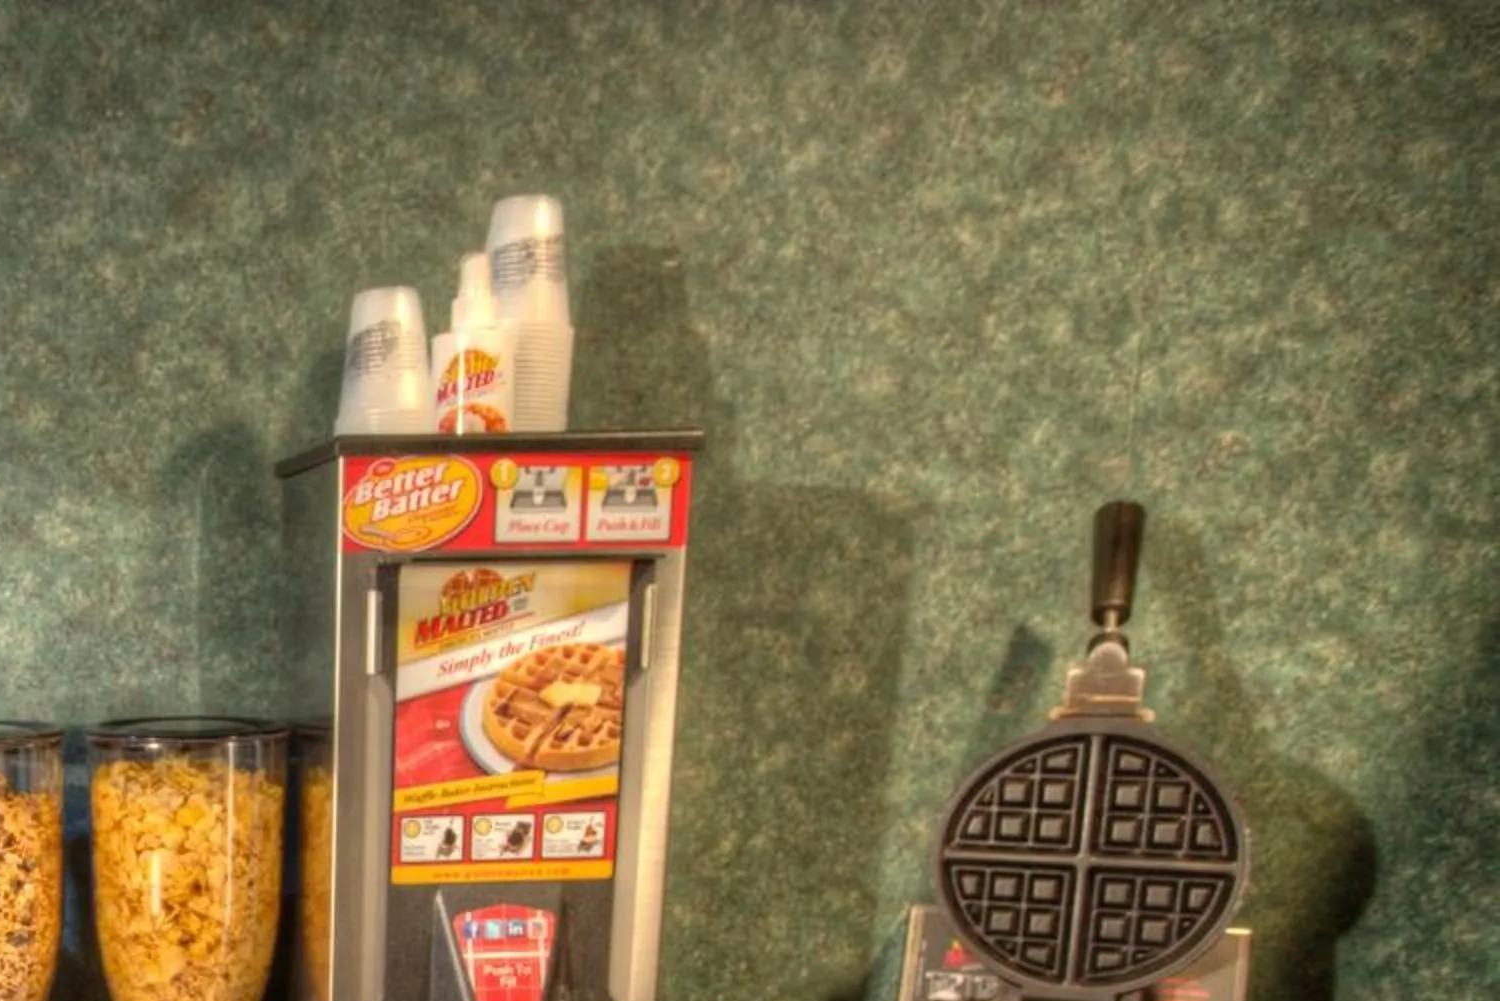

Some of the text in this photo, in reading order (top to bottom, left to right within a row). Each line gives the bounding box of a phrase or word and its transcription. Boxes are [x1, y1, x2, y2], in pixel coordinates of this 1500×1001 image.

[436, 370, 495, 403] MATED
[355, 460, 448, 505] Better
[372, 479, 465, 521] Batter
[414, 599, 509, 649] MALTED
[437, 648, 493, 677] Simply
[499, 638, 524, 658] the
